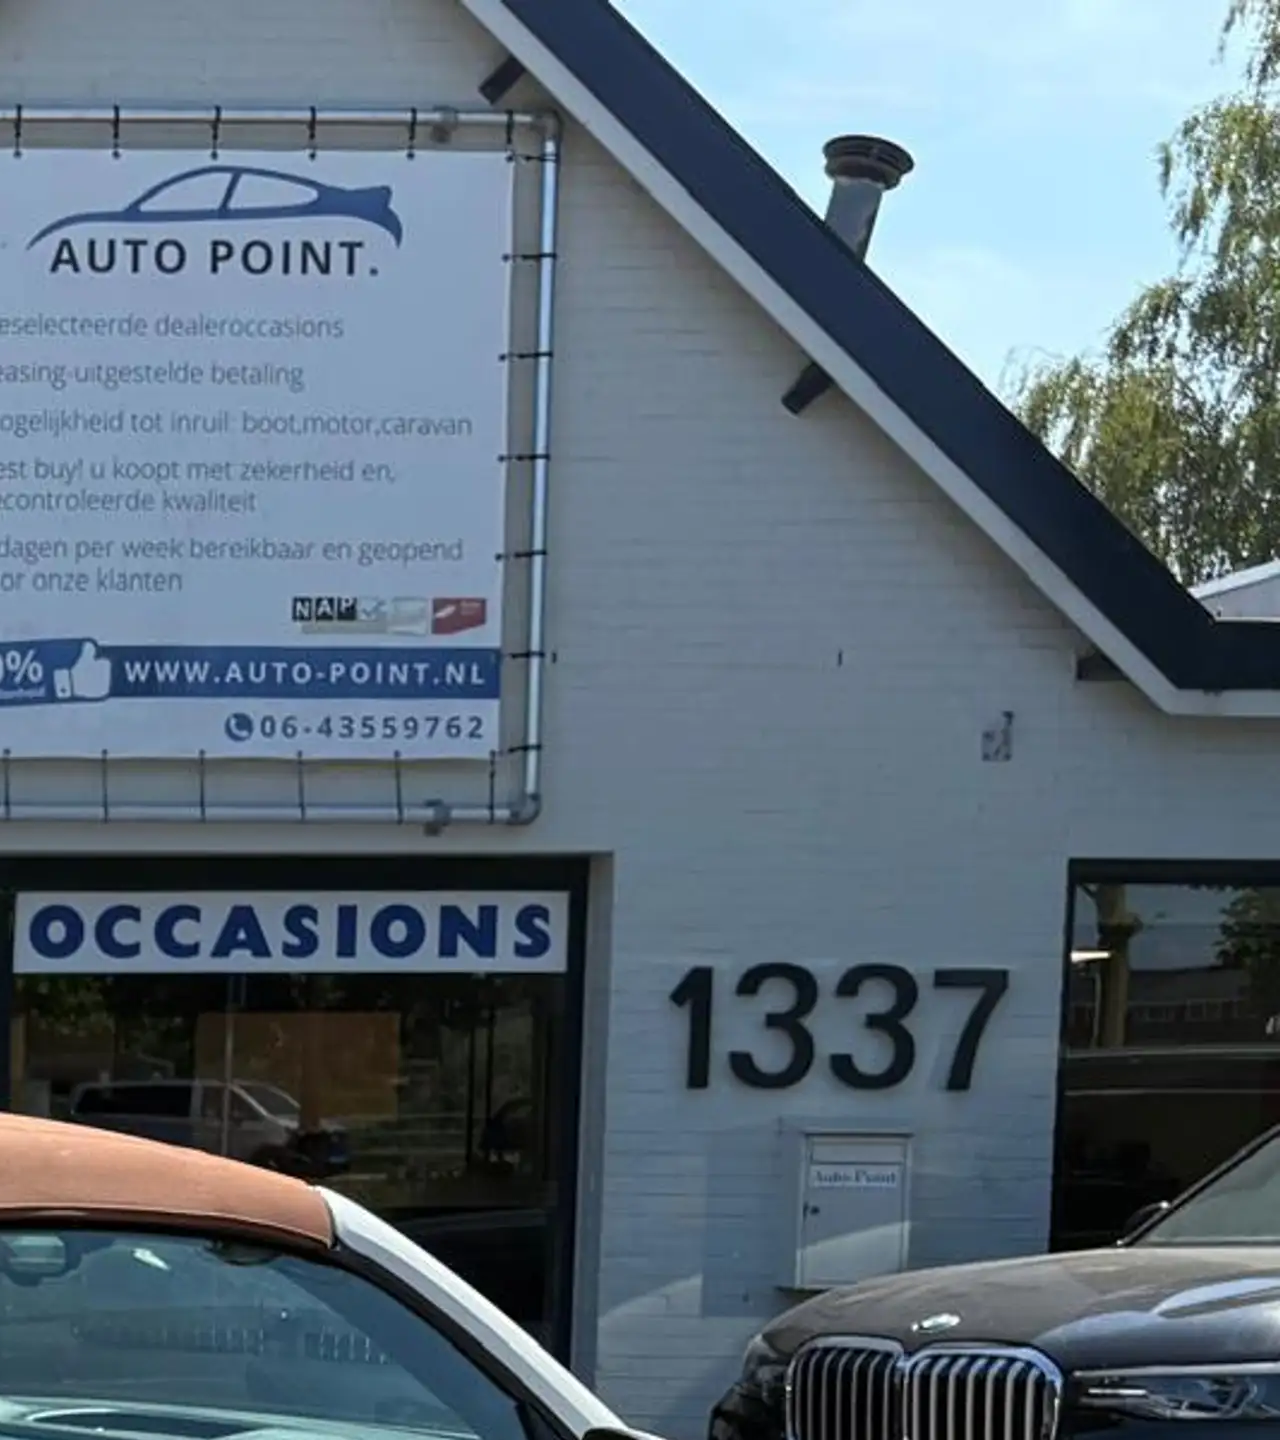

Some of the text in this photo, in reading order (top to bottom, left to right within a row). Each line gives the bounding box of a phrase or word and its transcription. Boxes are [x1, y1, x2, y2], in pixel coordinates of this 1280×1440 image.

[48, 238, 188, 275] AUTO
[154, 312, 344, 339] dealeroccasions
[210, 360, 305, 391] betaling
[131, 412, 163, 434] tot
[34, 458, 83, 488] buy!
[91, 464, 105, 480] u
[112, 459, 180, 488] koopt
[186, 462, 232, 481] met
[240, 460, 354, 483] zekerheid
[162, 490, 256, 513] kwaliteit
[74, 543, 116, 567] per
[122, 538, 183, 560] week
[190, 537, 316, 562] bereikbaar
[322, 544, 352, 562] en
[357, 538, 463, 569] geopend
[32, 574, 90, 592] onze
[96, 570, 183, 593] klanten
[292, 597, 357, 621] NAP
[124, 660, 486, 686] WWW.AUTO-POINT.NL
[259, 714, 484, 741] 06-43559762
[28, 903, 553, 960] OCCASIONS
[669, 962, 1010, 1091] 1337
